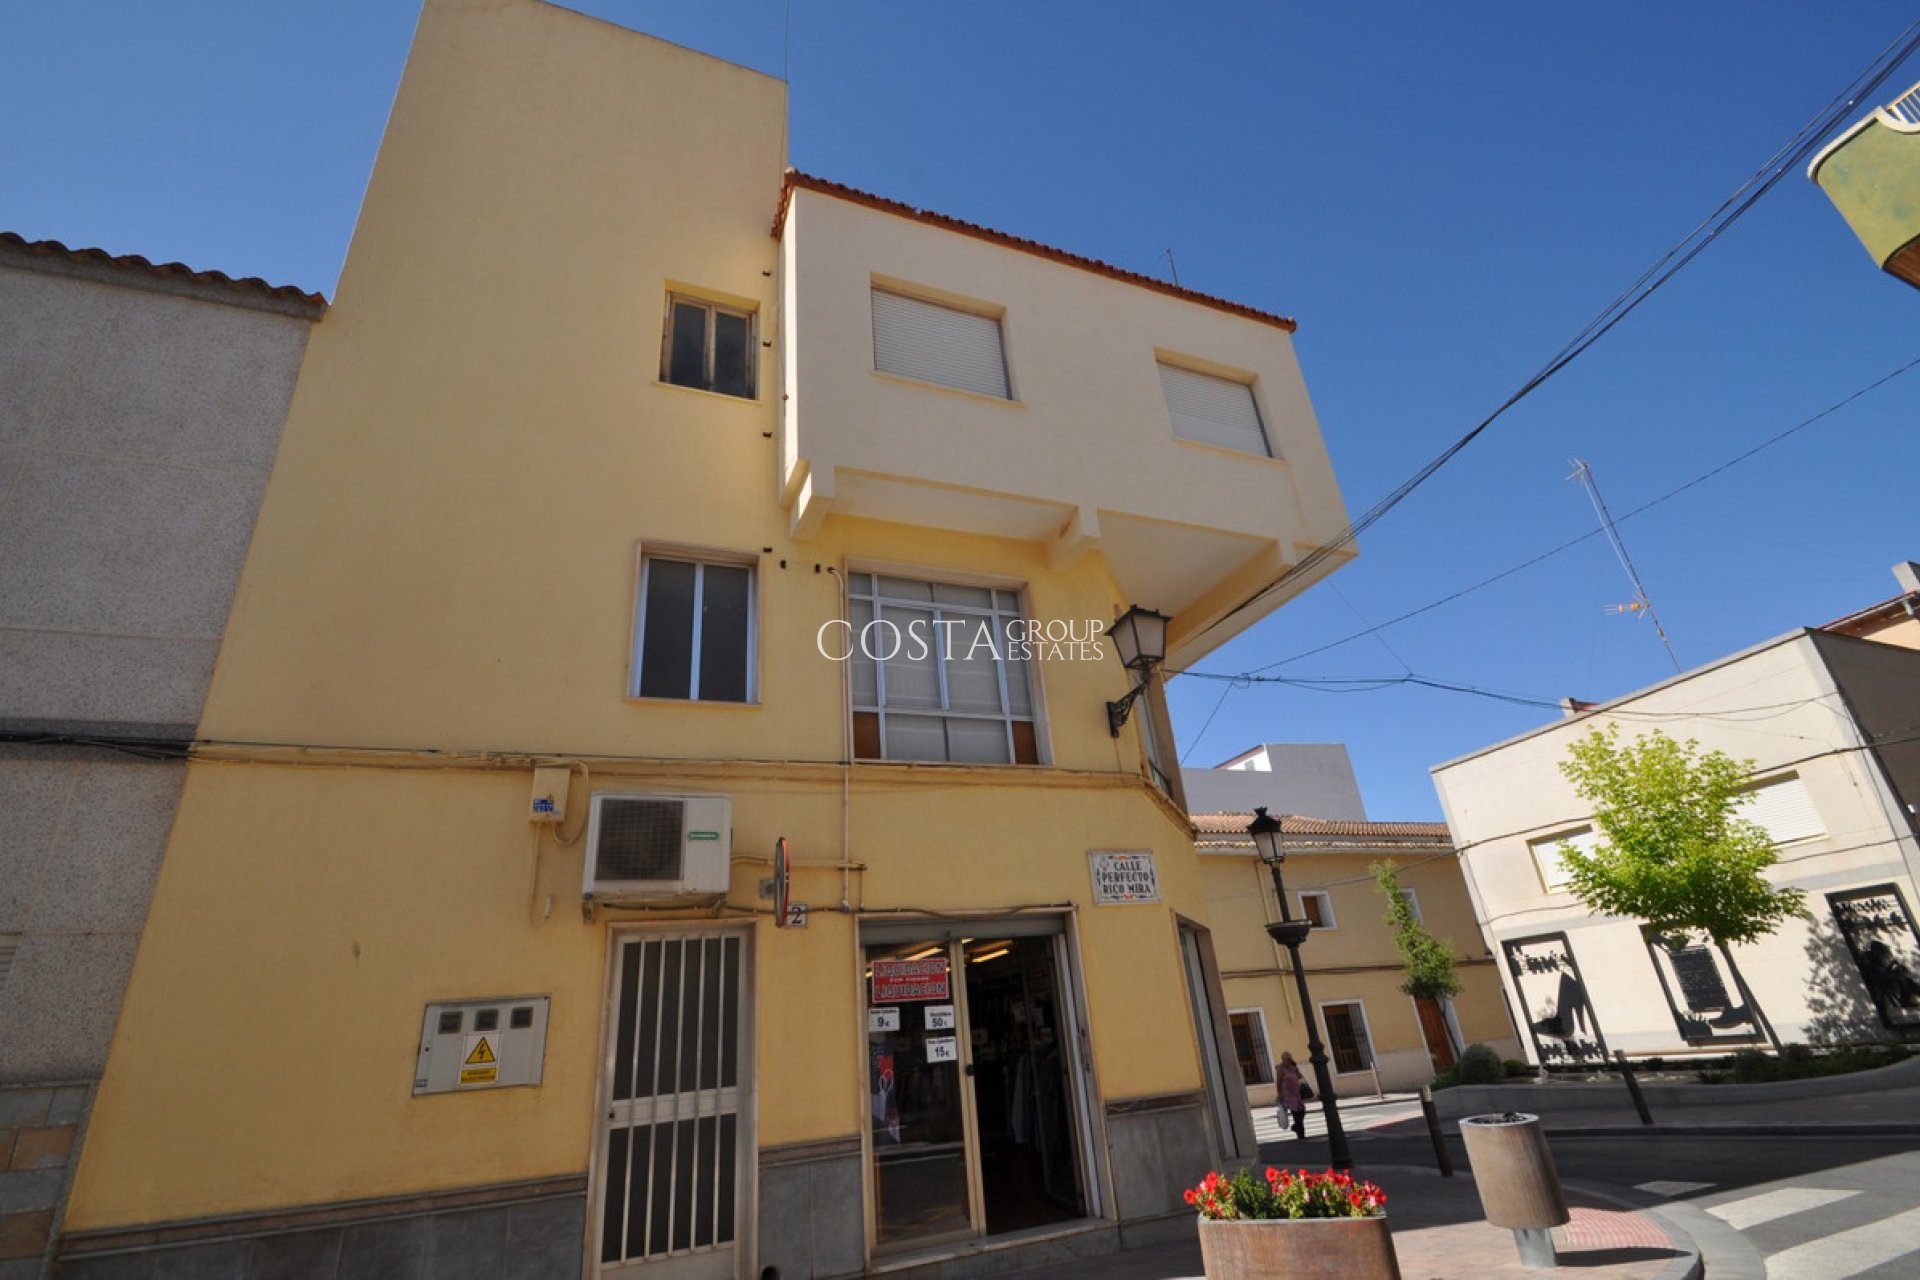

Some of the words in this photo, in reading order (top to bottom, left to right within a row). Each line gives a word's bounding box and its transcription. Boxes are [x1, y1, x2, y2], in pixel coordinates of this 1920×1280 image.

[1114, 861, 1142, 871] CALLE
[1101, 872, 1149, 882] PERFECTO
[1103, 884, 1125, 894] RICO
[1127, 883, 1151, 894] MIRA
[791, 906, 802, 924] 2
